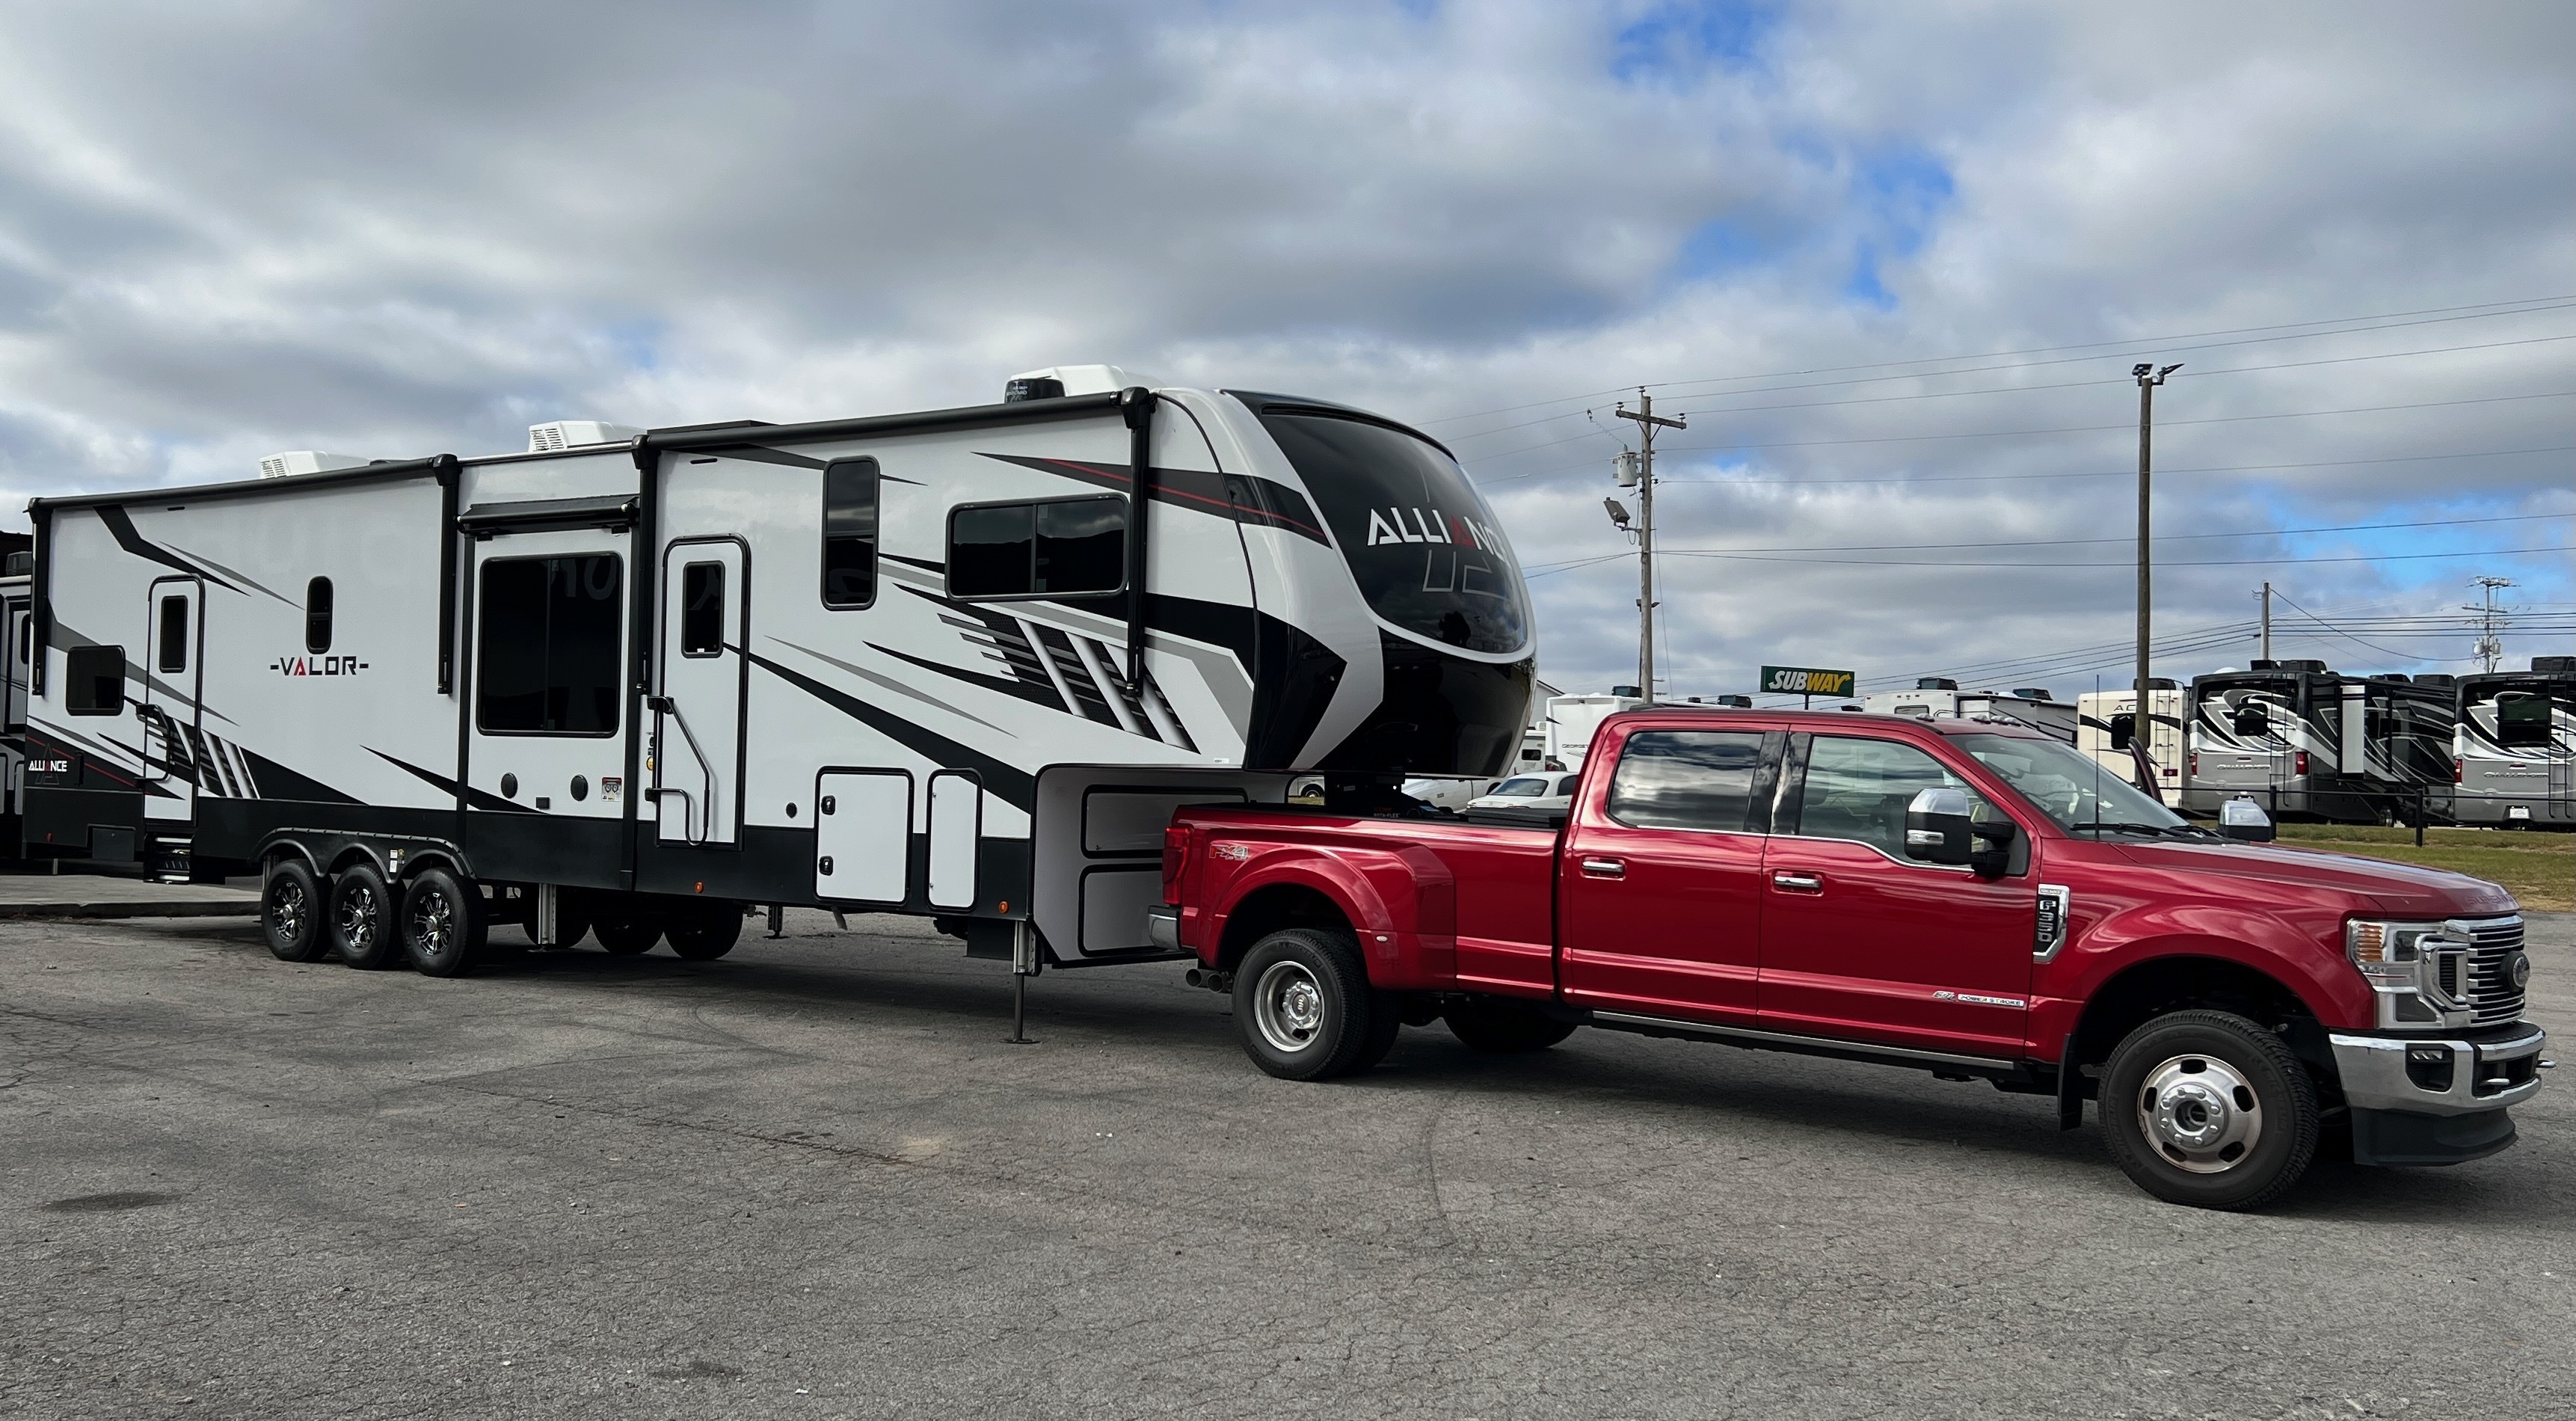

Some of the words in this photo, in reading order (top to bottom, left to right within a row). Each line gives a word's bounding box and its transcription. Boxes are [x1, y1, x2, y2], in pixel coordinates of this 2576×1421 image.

[1768, 671, 1851, 693] SUBWAY
[28, 760, 67, 772] ALLIANCE
[1209, 844, 1248, 859] FX4
